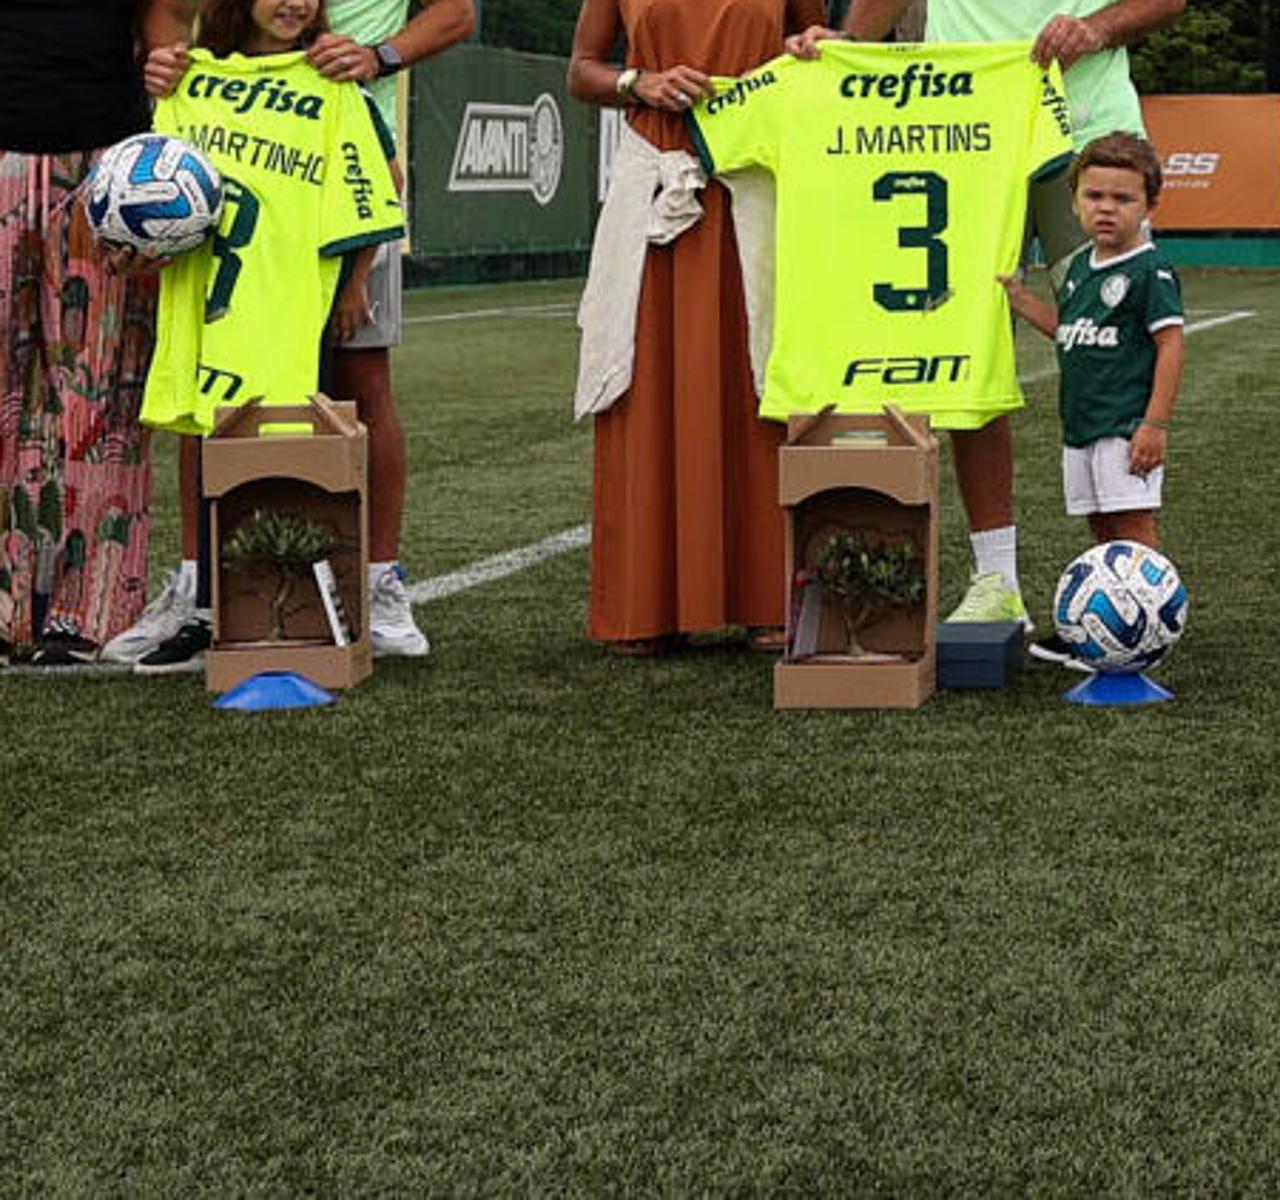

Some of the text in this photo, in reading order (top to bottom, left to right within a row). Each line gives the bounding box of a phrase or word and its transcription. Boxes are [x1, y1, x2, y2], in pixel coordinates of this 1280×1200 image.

[187, 73, 325, 121] crefisa
[839, 62, 973, 109] crefisa
[460, 119, 527, 175] AVANTI
[1161, 152, 1221, 175] SS
[341, 141, 373, 219] crefisa
[873, 171, 949, 313] 3
